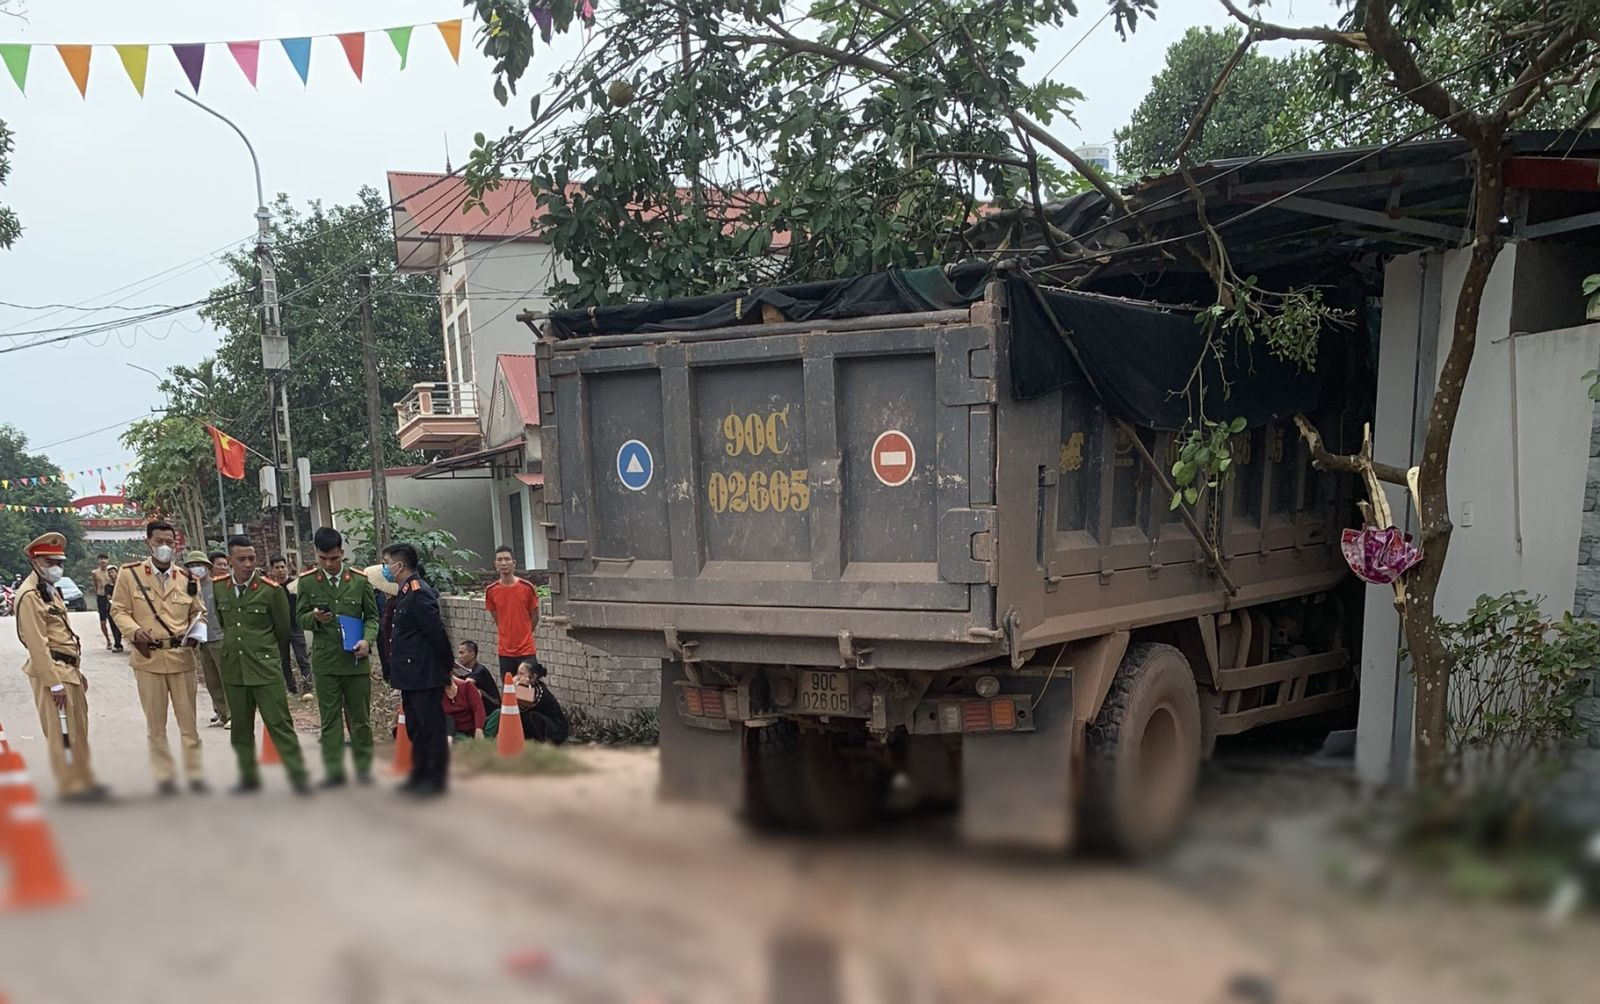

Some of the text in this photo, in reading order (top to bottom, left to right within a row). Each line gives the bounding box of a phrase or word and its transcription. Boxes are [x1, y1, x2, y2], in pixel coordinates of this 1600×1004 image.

[723, 411, 790, 457] 90C
[708, 468, 810, 513] 02605
[811, 673, 838, 692] 90C
